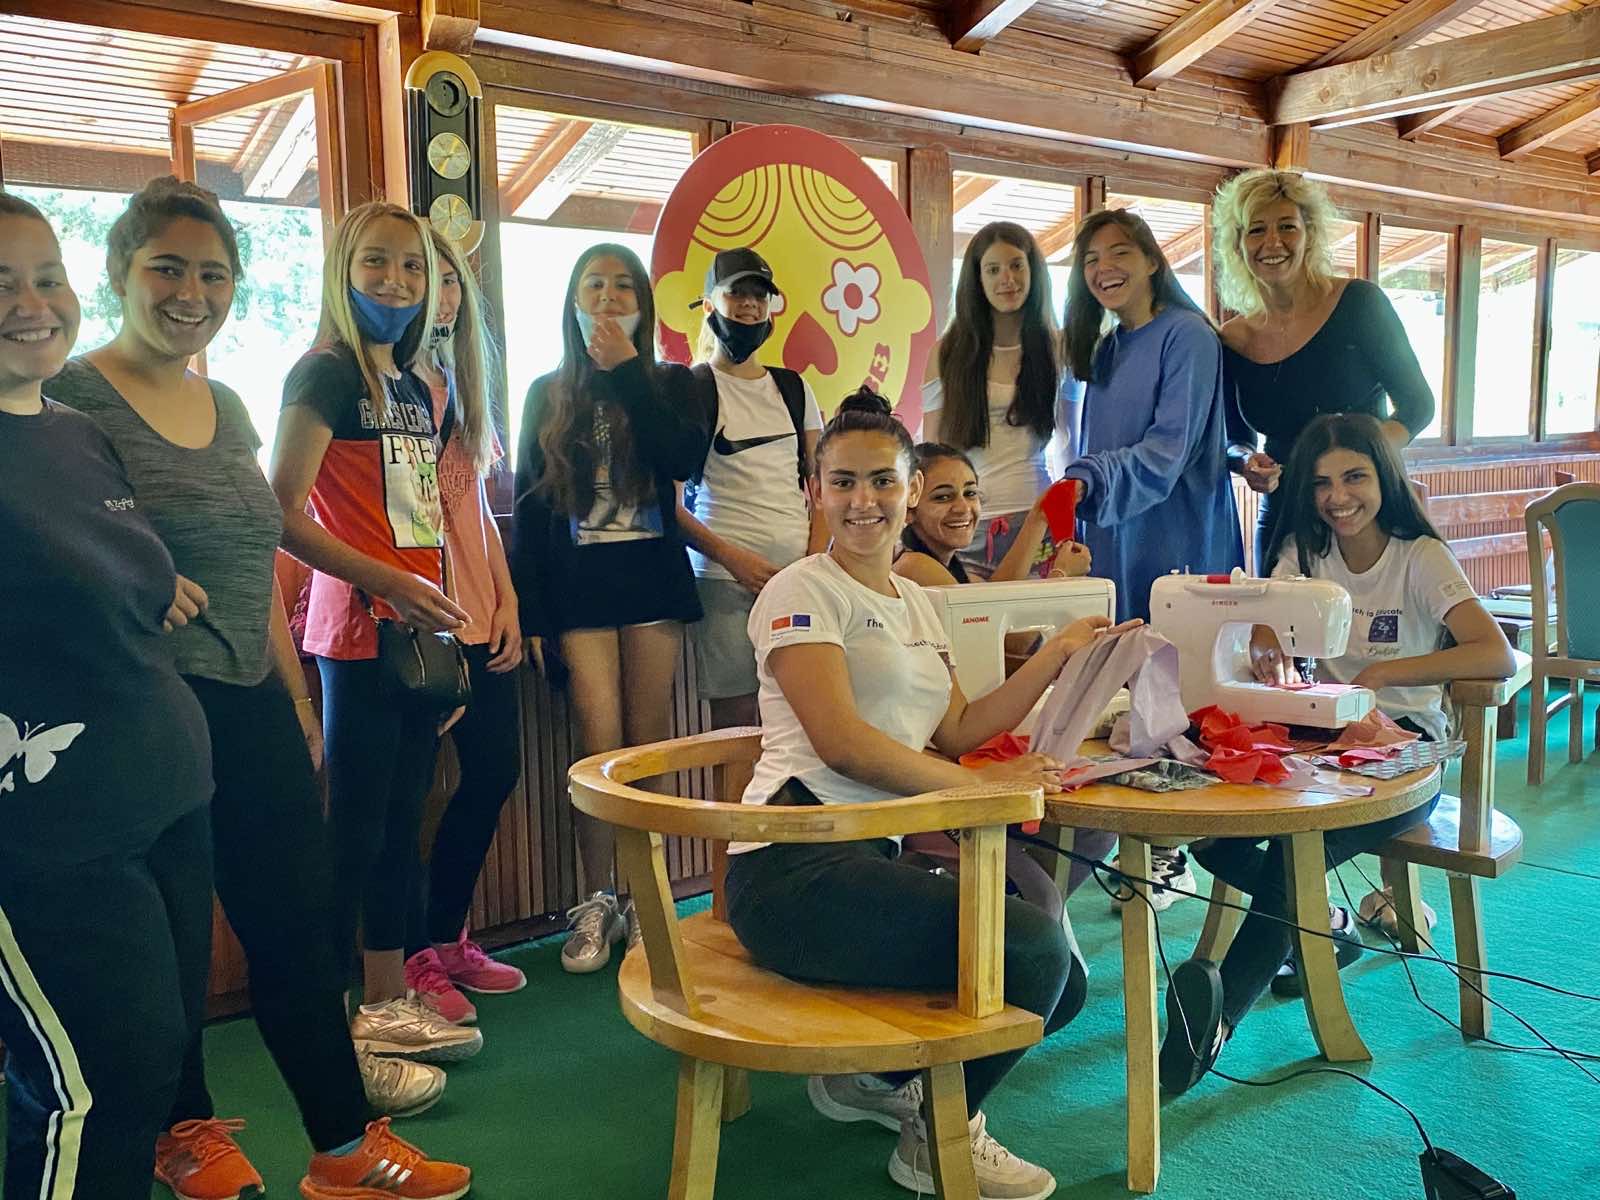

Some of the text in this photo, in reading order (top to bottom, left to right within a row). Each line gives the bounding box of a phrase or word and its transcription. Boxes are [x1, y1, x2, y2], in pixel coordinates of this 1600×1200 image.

[386, 434, 437, 465] FRE
[866, 618, 884, 629] The
[962, 615, 989, 624] JANOME
